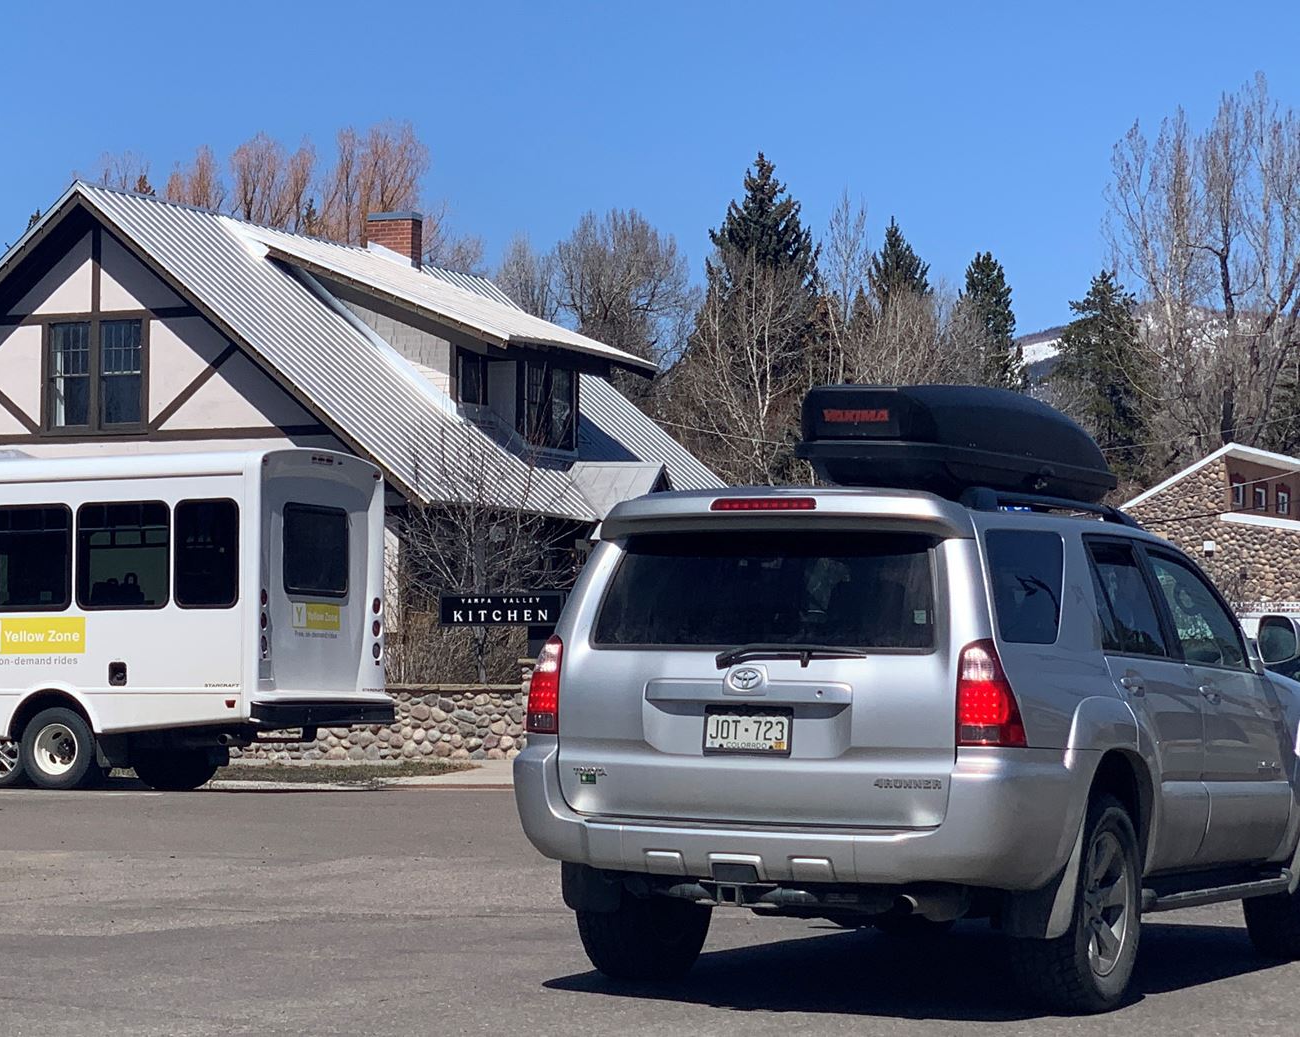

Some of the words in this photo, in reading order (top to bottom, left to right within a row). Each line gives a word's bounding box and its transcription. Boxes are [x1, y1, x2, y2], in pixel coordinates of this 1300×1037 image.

[823, 409, 889, 422] YAKIMA
[453, 609, 548, 622] KITCHEN
[4, 630, 45, 643] Yellow
[47, 629, 80, 642] Zone
[0, 656, 51, 666] on-demand
[54, 655, 78, 665] rides
[726, 741, 767, 749] COLORADO
[873, 779, 942, 790] 4RUNNER
